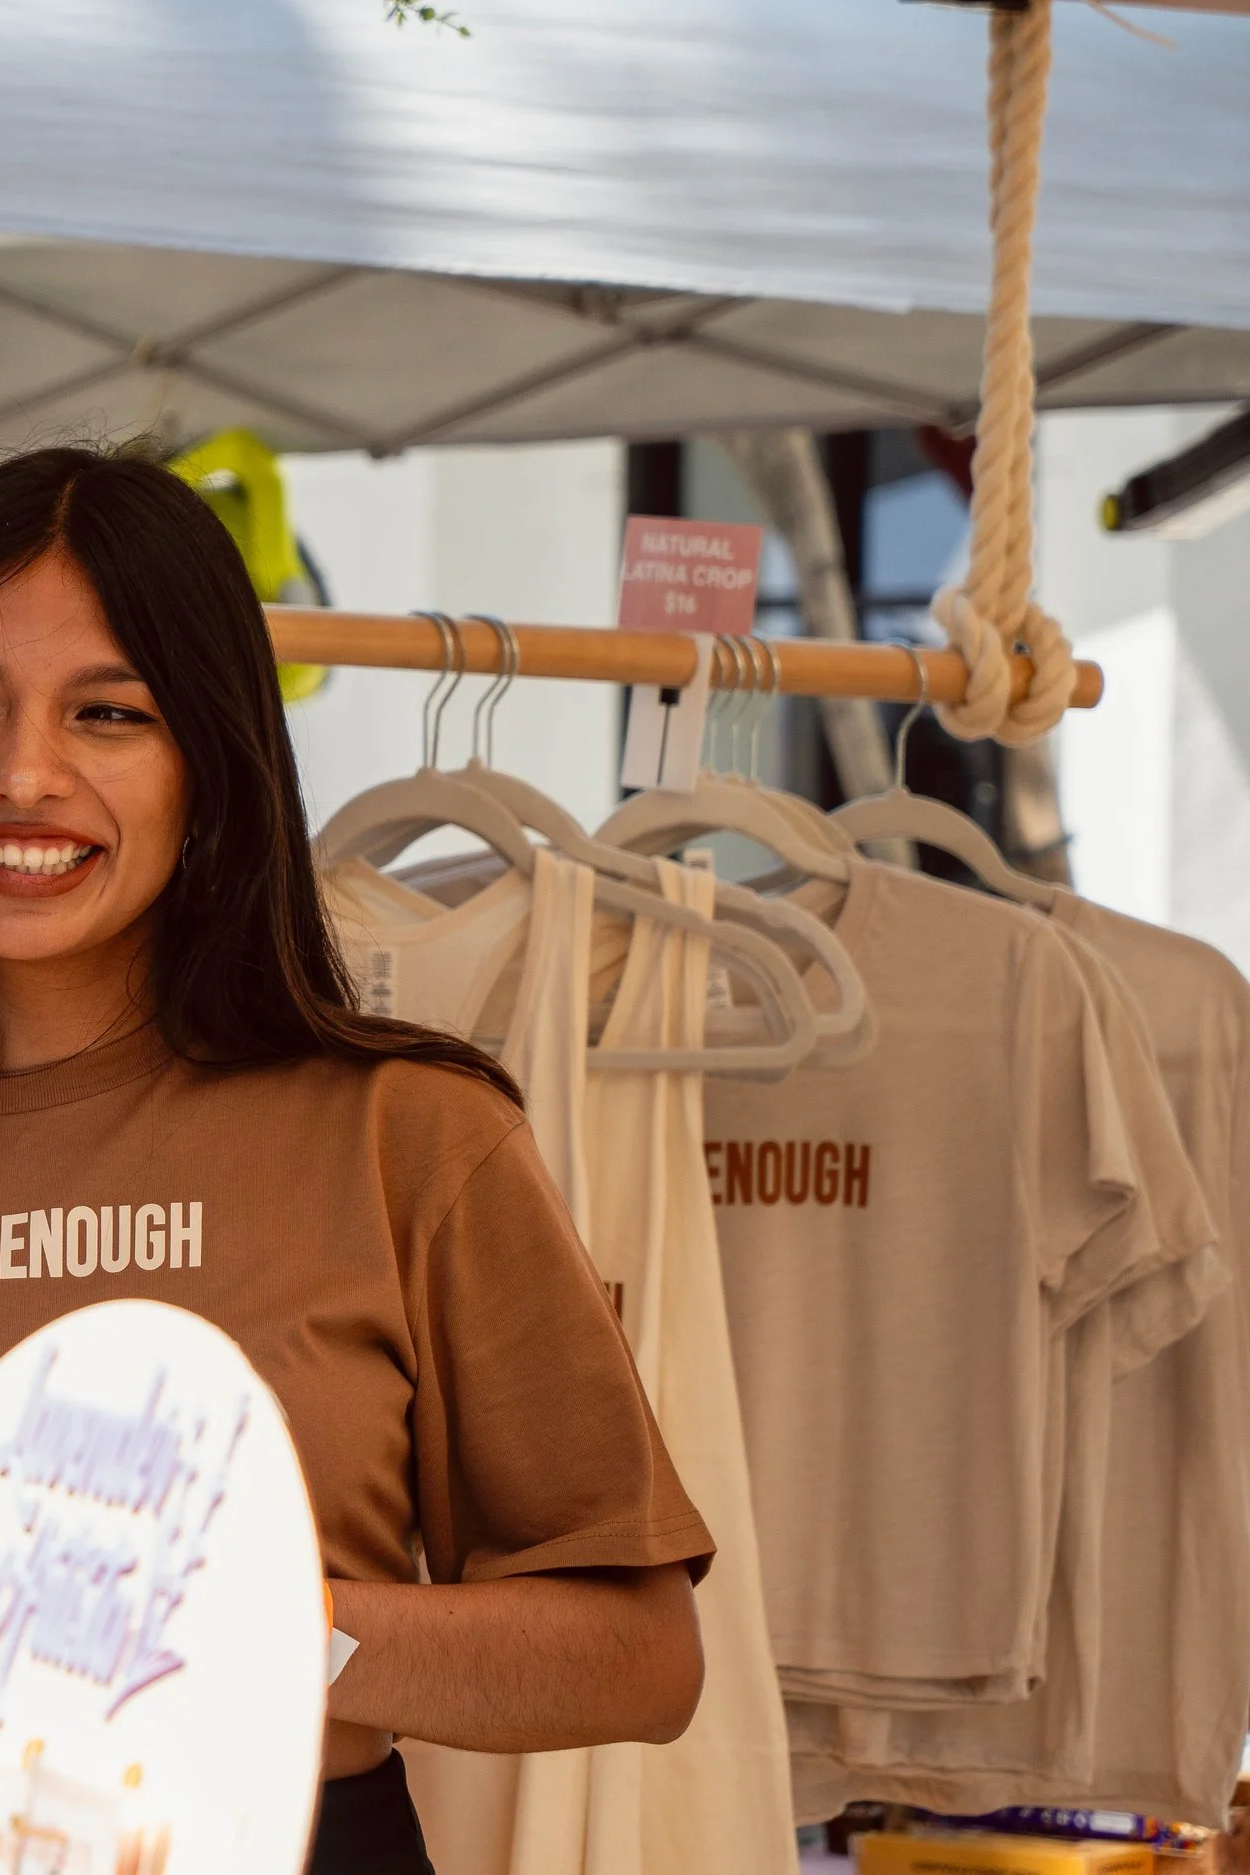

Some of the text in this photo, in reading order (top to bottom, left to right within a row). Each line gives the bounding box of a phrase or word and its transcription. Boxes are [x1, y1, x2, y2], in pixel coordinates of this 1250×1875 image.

[642, 532, 733, 559] NATURAL
[691, 564, 753, 590] CROP
[703, 1141, 871, 1208] ENOUGH
[0, 1201, 203, 1279] ENOUGH
